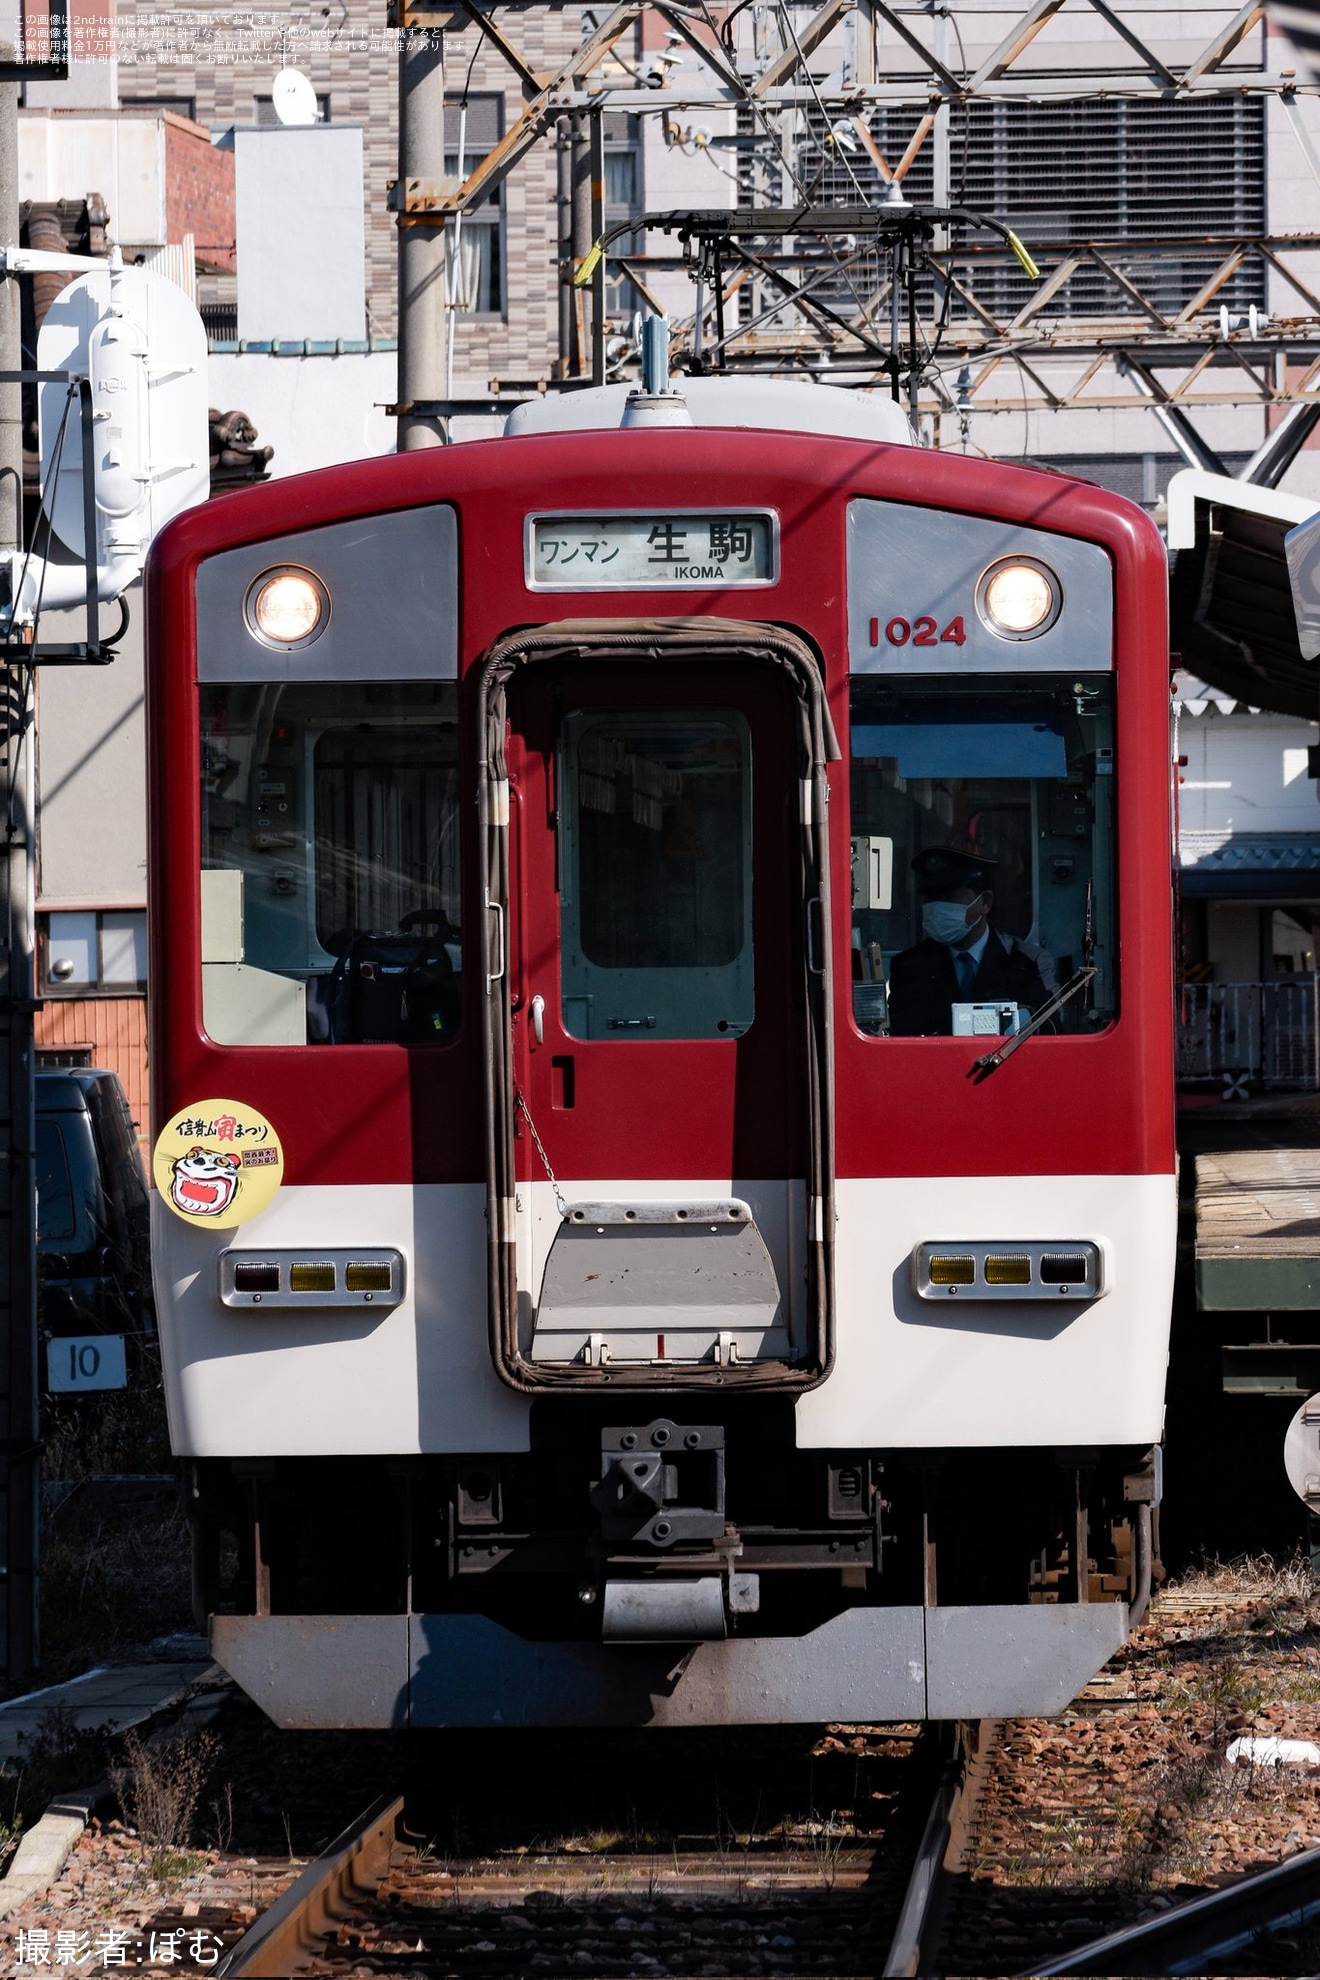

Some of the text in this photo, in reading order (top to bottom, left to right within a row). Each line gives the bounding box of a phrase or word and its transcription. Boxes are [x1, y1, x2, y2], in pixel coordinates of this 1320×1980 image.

[539, 539, 620, 565] ワンマン
[646, 521, 753, 564] 生駒
[674, 566, 725, 579] IKOMA
[870, 616, 966, 646] 1024
[70, 1344, 101, 1381] 10
